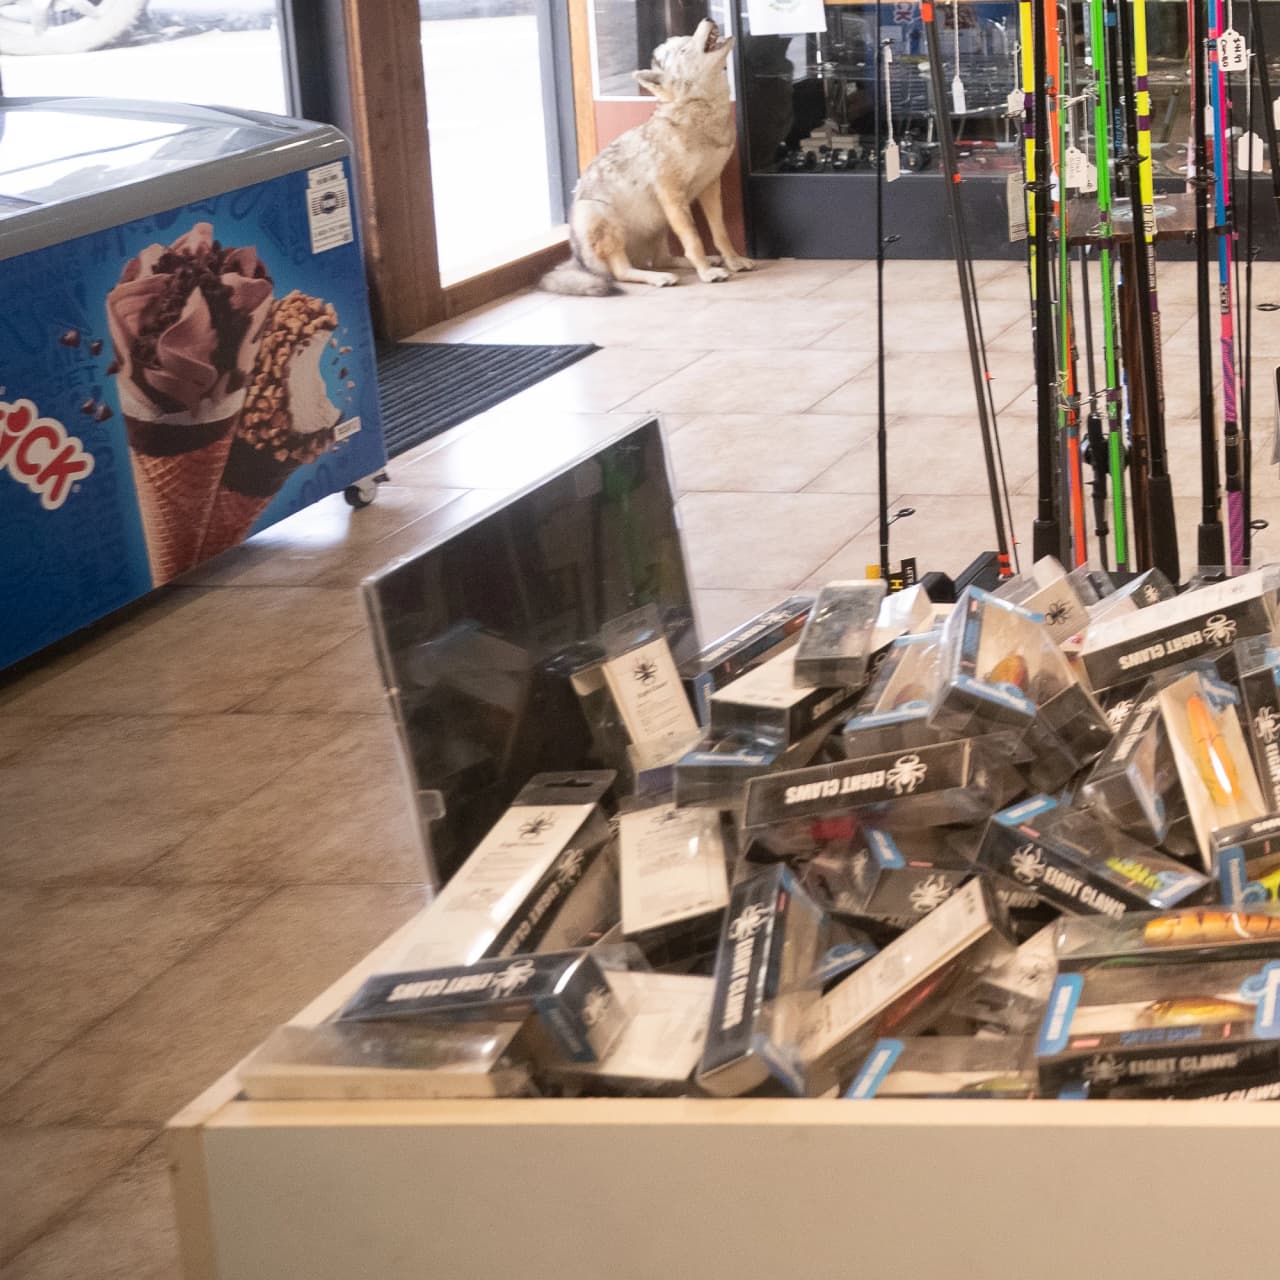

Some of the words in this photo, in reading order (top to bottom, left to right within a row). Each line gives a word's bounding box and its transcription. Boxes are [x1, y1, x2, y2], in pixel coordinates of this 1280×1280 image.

[1166, 630, 1203, 655] EIGHT
[1118, 644, 1165, 670] CLAWS
[839, 769, 887, 795] EIGHT
[1043, 865, 1084, 897] EIGHT
[1079, 884, 1127, 920] CLAWS
